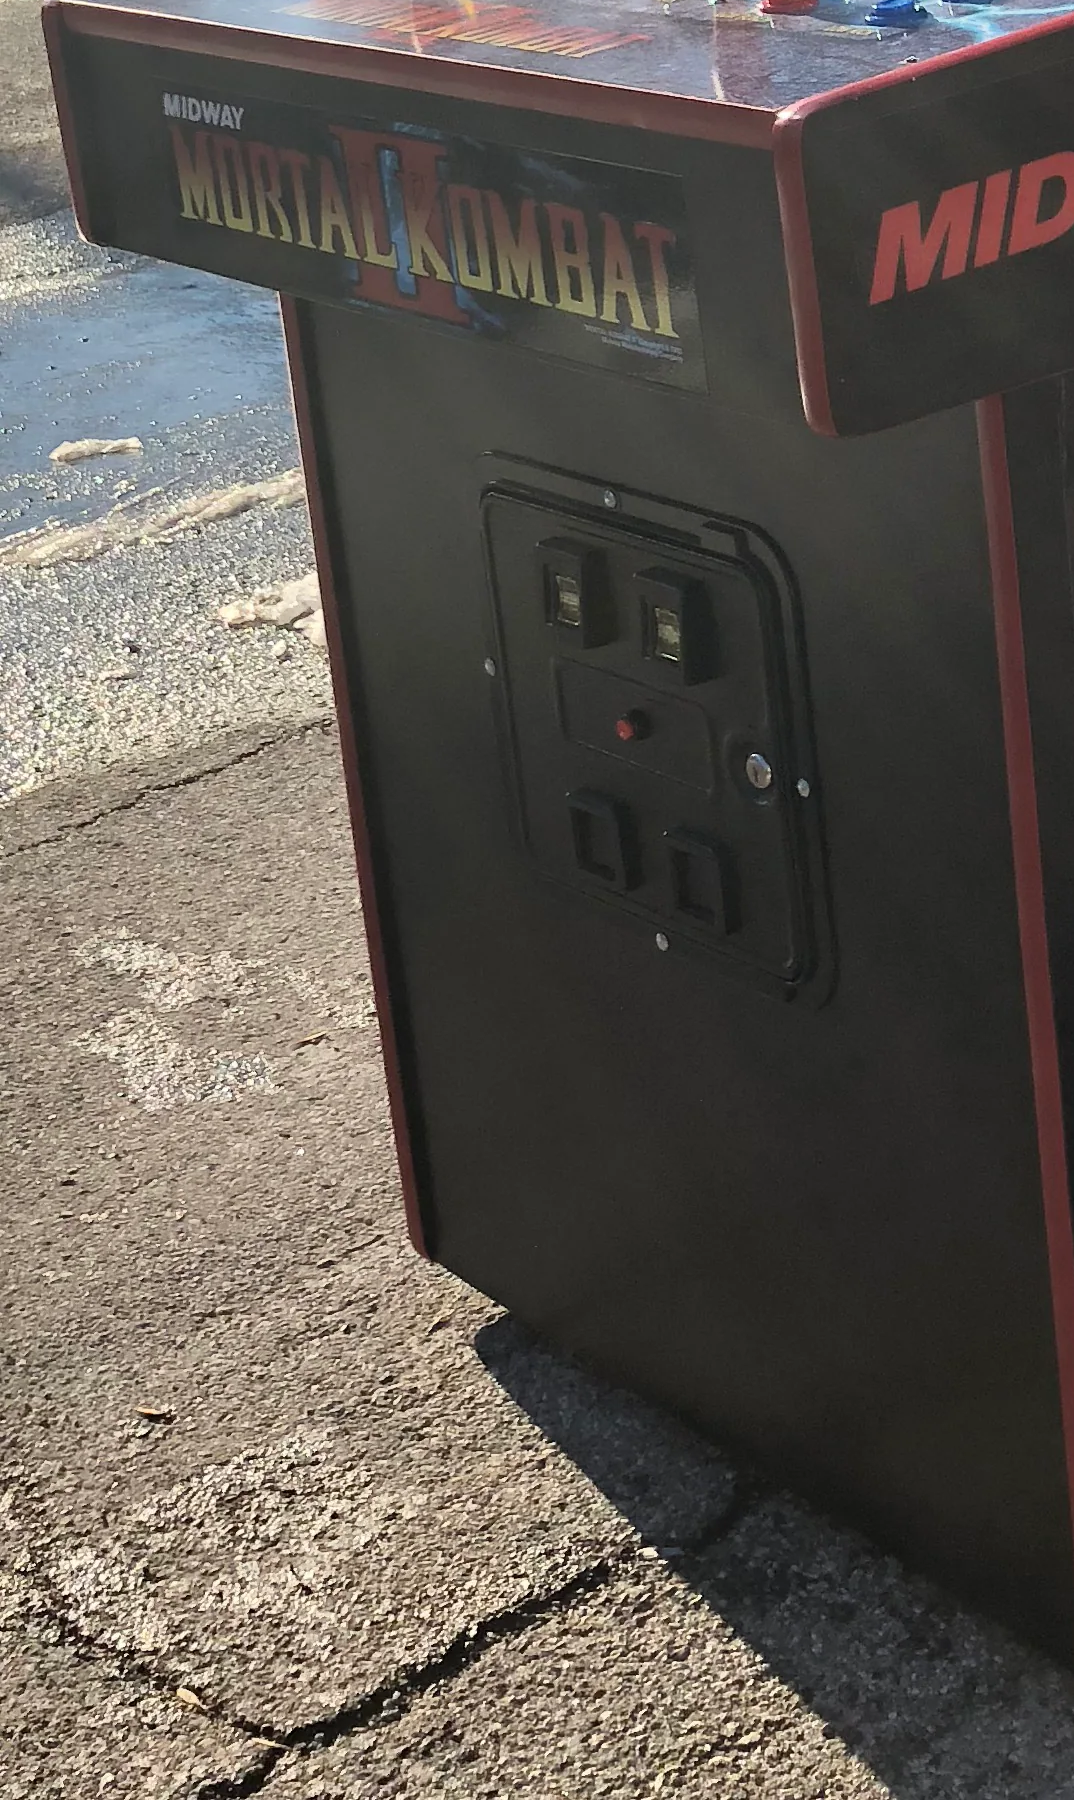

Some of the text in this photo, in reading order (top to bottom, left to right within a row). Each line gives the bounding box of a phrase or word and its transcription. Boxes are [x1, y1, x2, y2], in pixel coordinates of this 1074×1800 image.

[163, 92, 244, 130] MIDWAY
[169, 123, 680, 338] MORTAL KOMBAT
